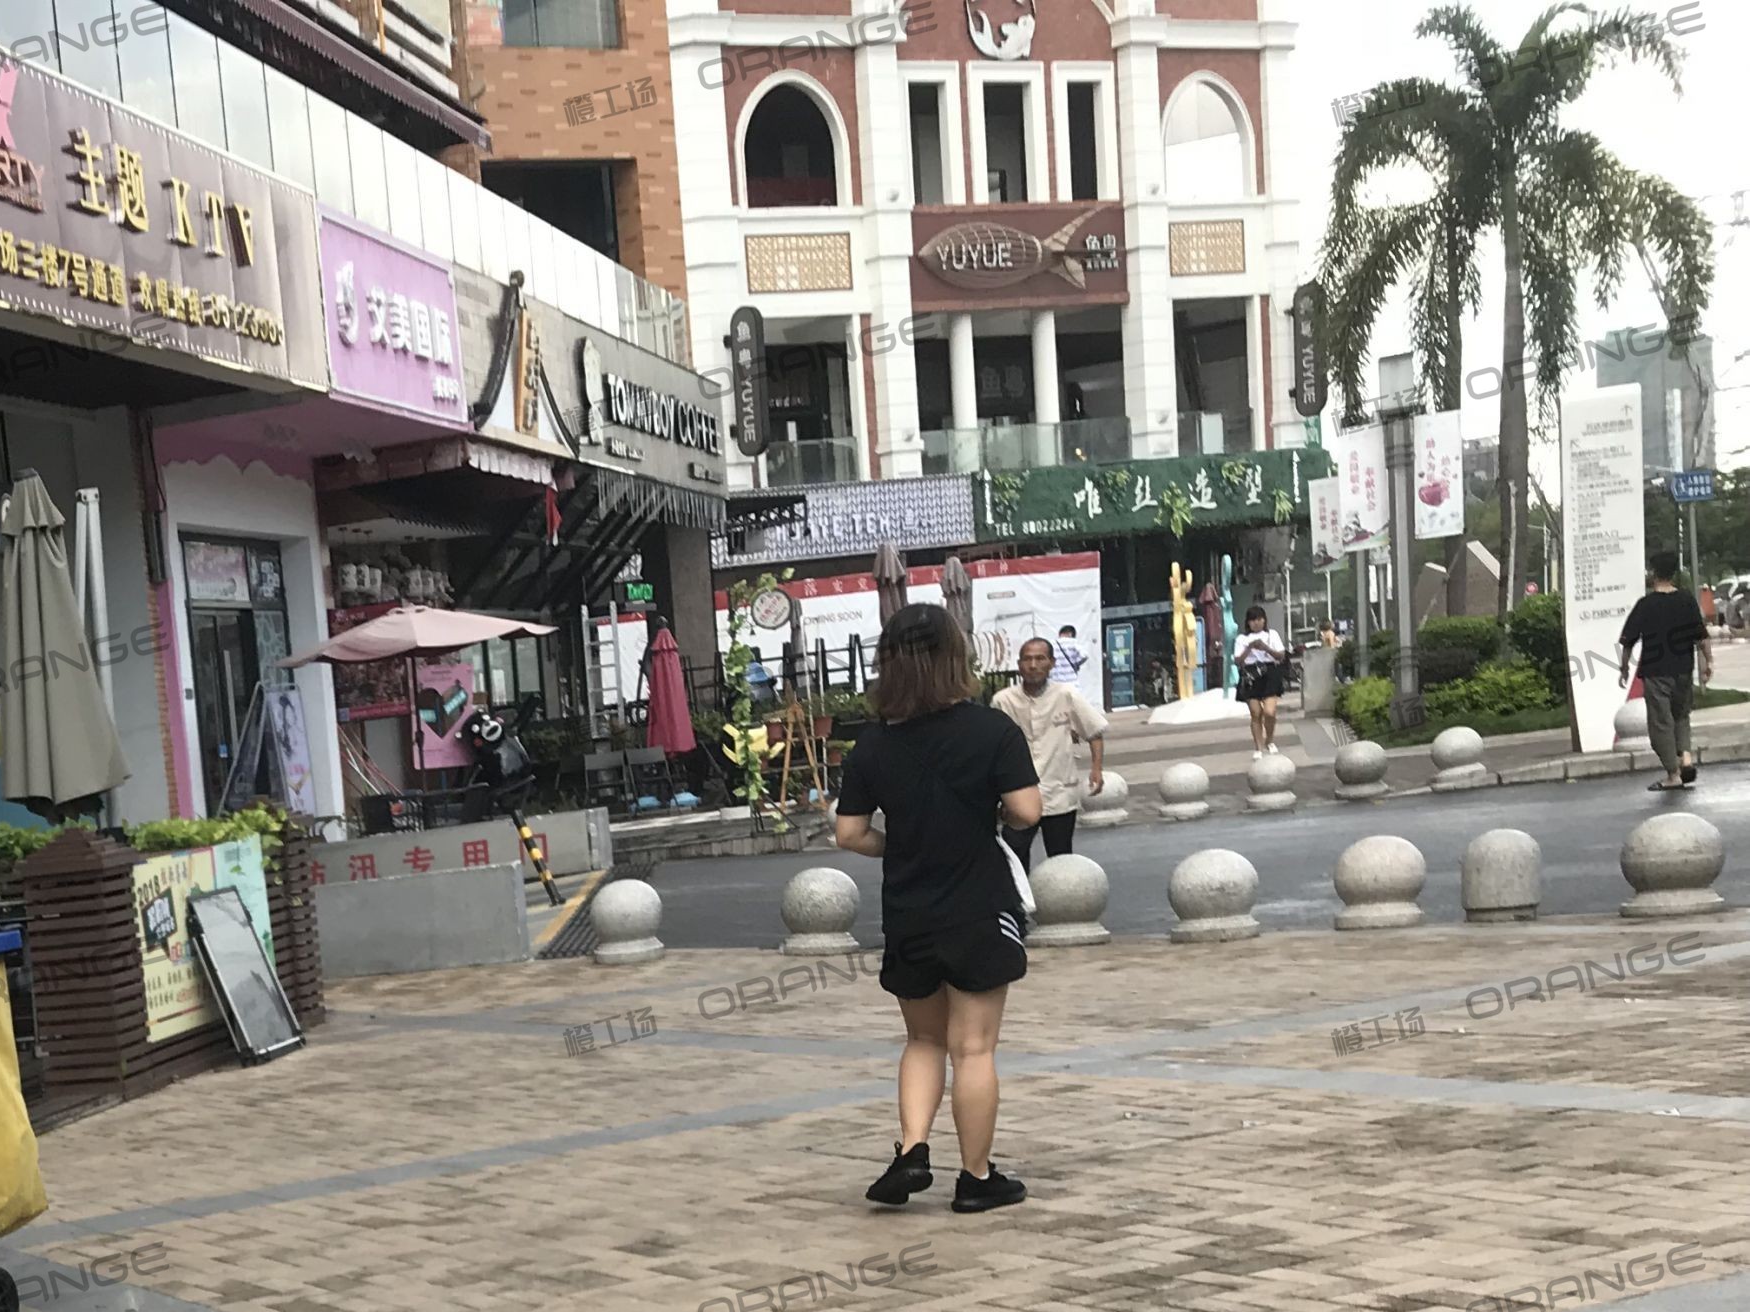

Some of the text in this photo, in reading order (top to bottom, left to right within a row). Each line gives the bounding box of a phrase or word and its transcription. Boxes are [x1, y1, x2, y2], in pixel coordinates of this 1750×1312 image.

[937, 242, 1013, 270] YUYUE
[1302, 344, 1316, 404] YUYUE
[678, 400, 724, 455] COFFEE
[741, 376, 756, 442] YUYUE
[1074, 465, 1262, 520] 唯丝造型
[996, 522, 1015, 535] TEL
